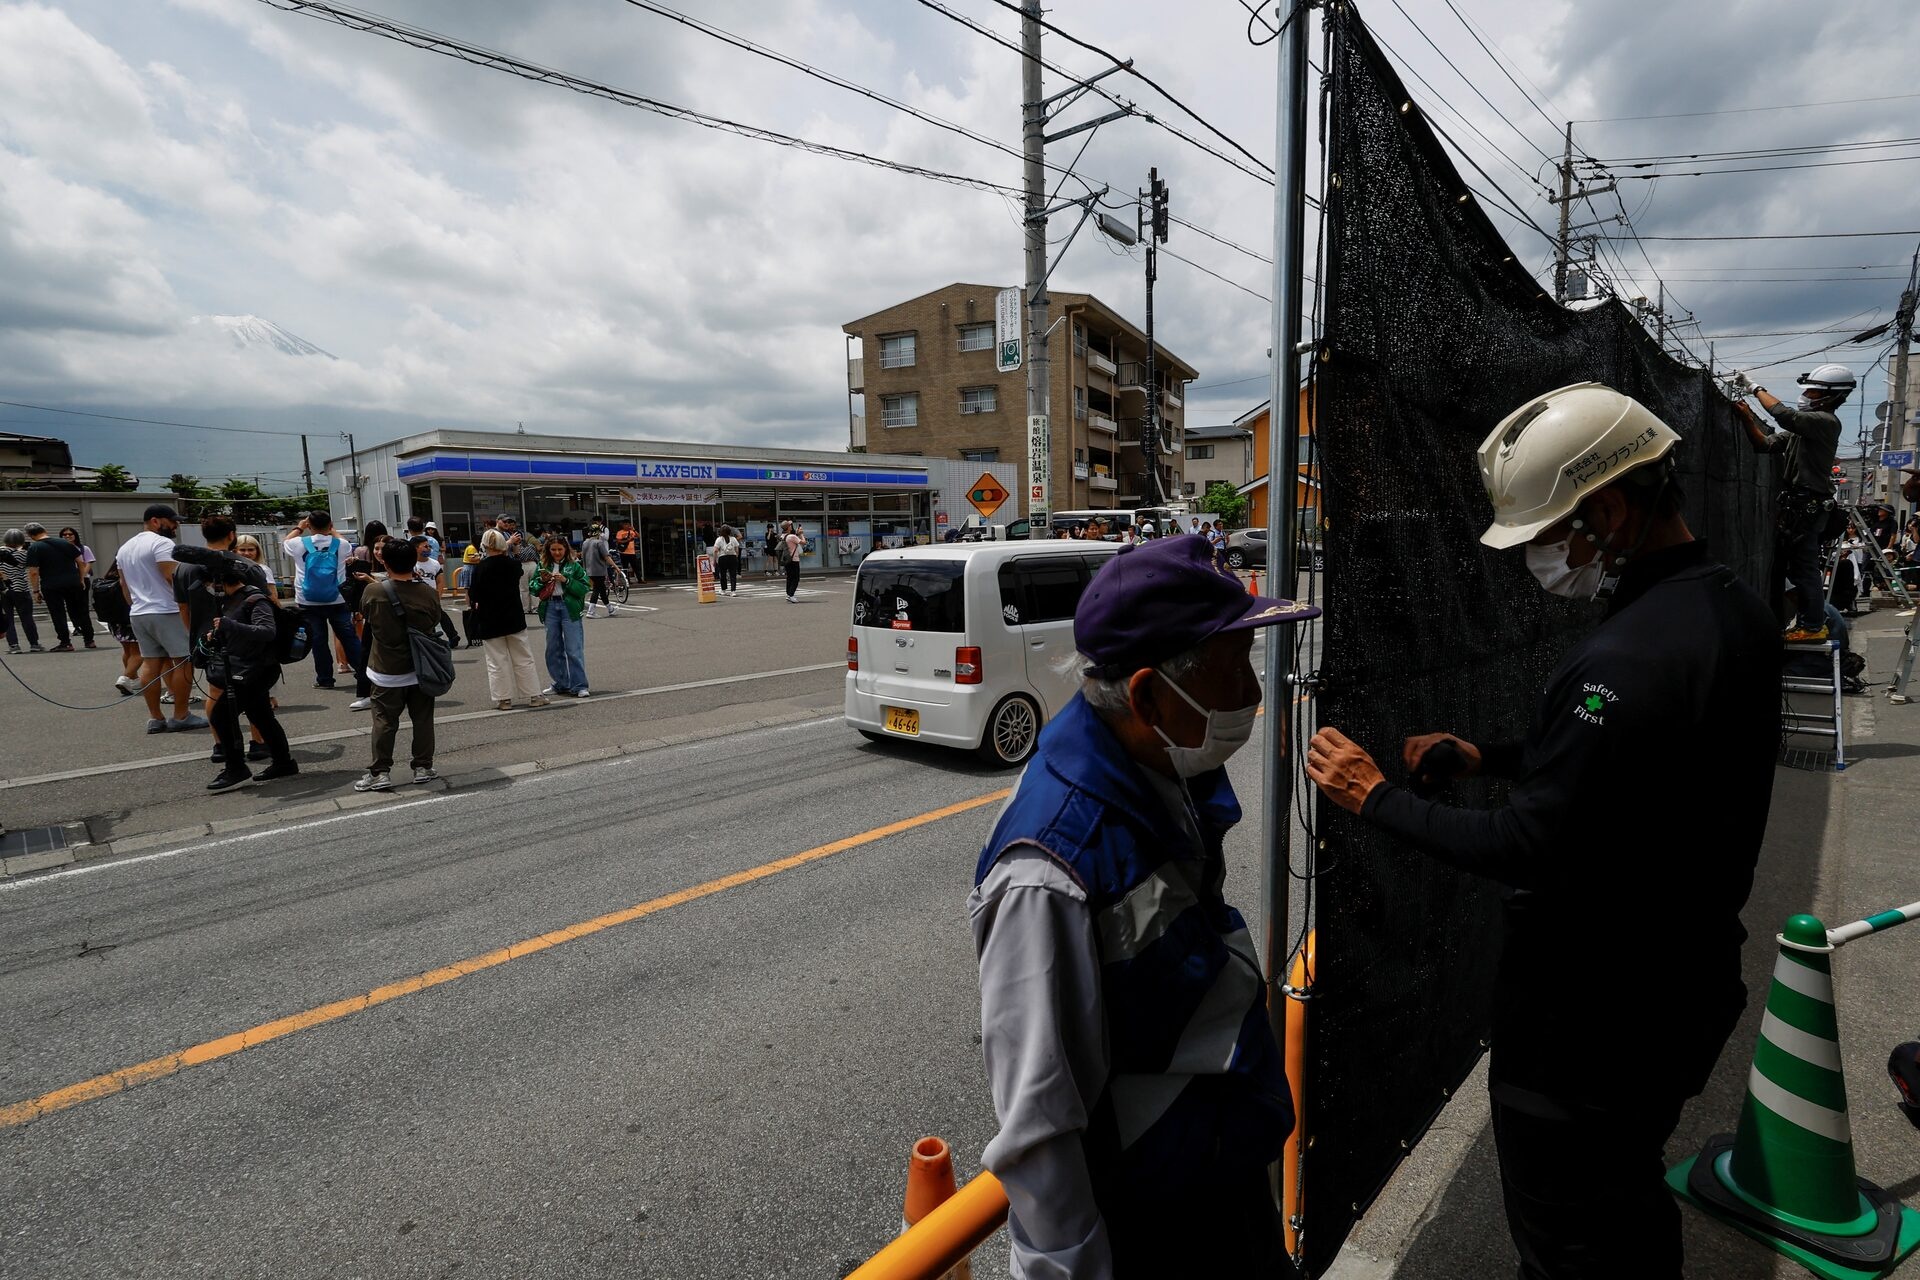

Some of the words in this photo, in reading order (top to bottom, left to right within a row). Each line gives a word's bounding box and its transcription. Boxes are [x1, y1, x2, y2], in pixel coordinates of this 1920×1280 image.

[1564, 452, 1601, 478] 株式会社
[1572, 427, 1659, 489] パークプラン工業
[641, 464, 713, 478] LAWSON
[1583, 682, 1620, 702] Safety
[893, 717, 917, 732] 46-66
[1573, 705, 1604, 726] First
